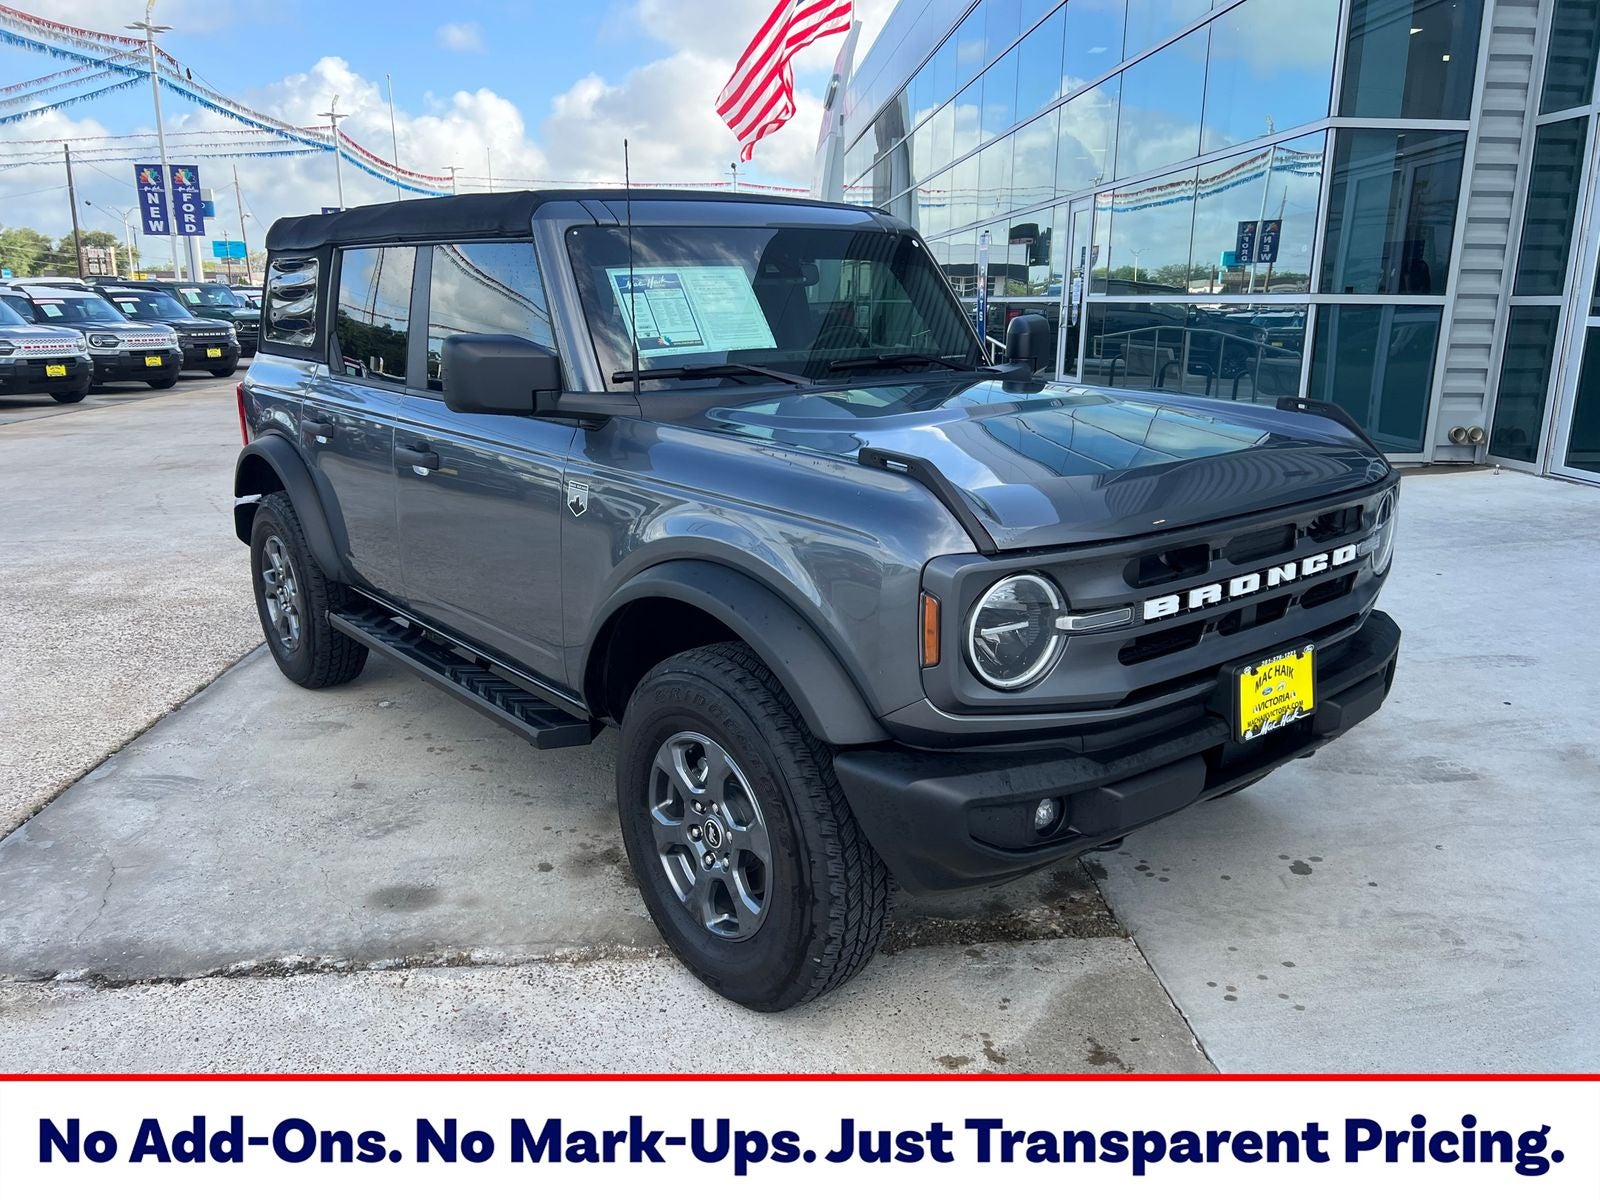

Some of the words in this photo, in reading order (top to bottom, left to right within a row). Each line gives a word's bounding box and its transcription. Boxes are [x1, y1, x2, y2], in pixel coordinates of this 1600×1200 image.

[147, 192, 164, 232] NEW
[182, 193, 197, 233] FORD
[1143, 543, 1356, 621] BRONCO
[1254, 667, 1273, 693] MAC
[1274, 664, 1294, 680] HAIK
[1257, 692, 1291, 712] VICTORIA
